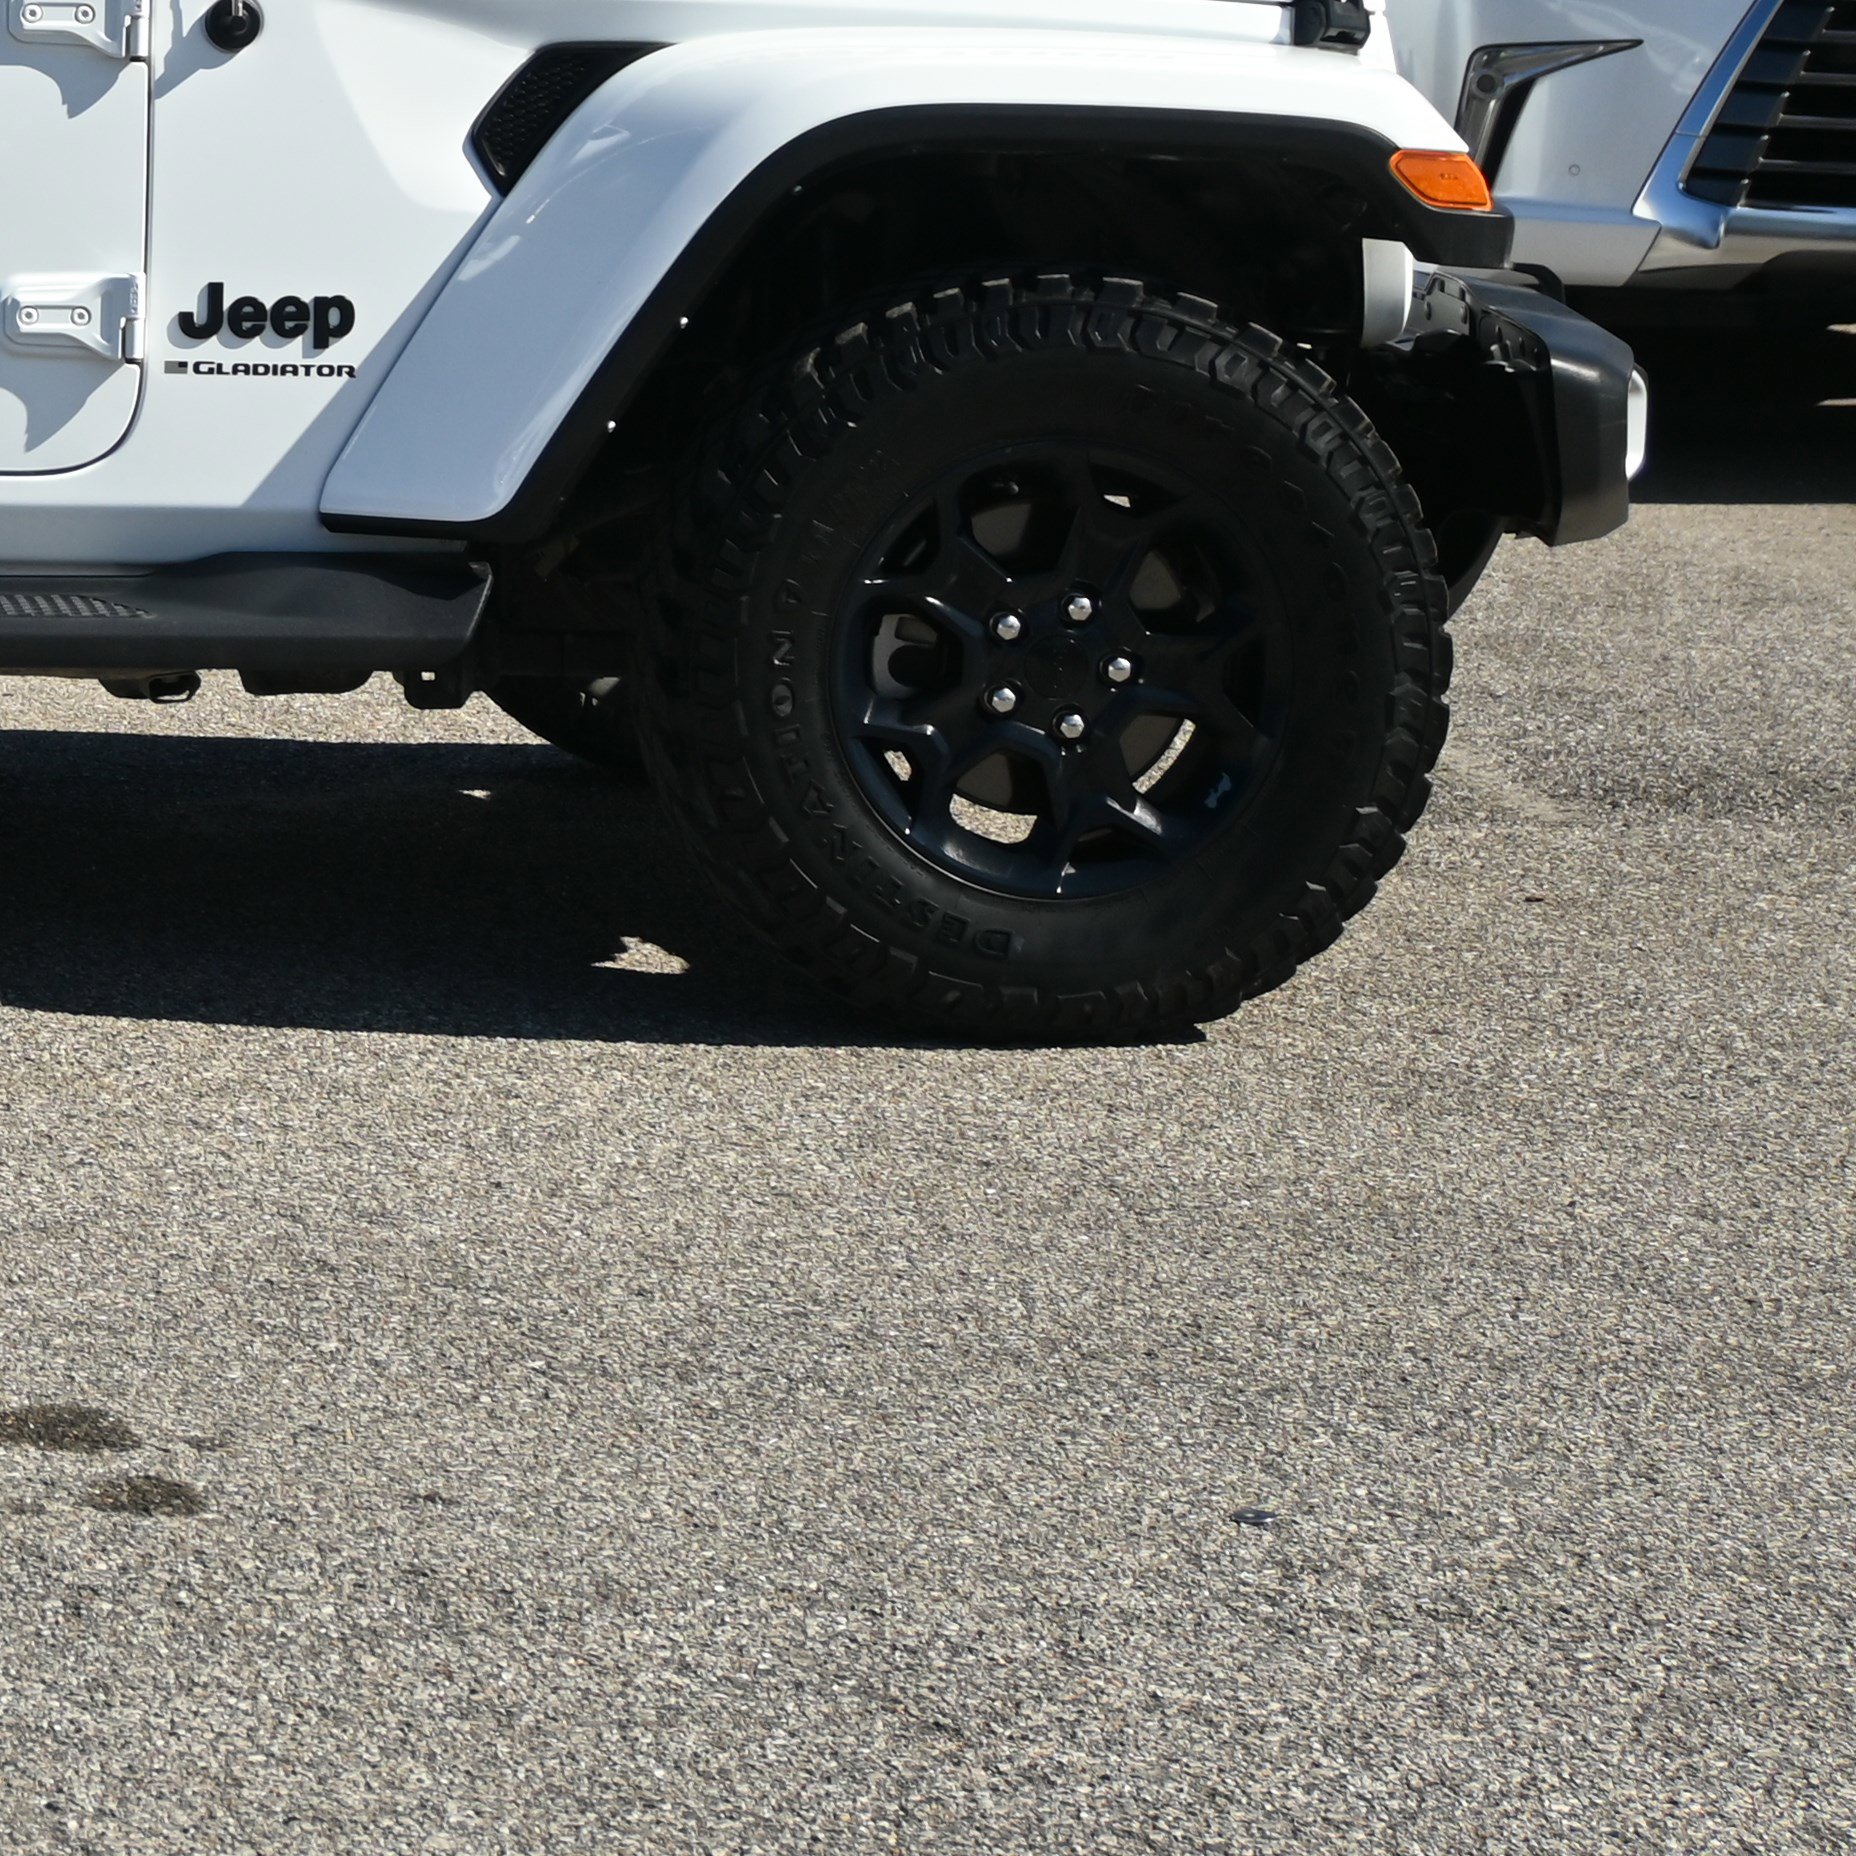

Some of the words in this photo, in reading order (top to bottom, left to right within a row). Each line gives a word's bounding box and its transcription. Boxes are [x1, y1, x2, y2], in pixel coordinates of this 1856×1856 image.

[178, 281, 356, 350] Jeep
[192, 360, 357, 379] GLADIATOR
[768, 632, 1014, 960] DESTINATION
